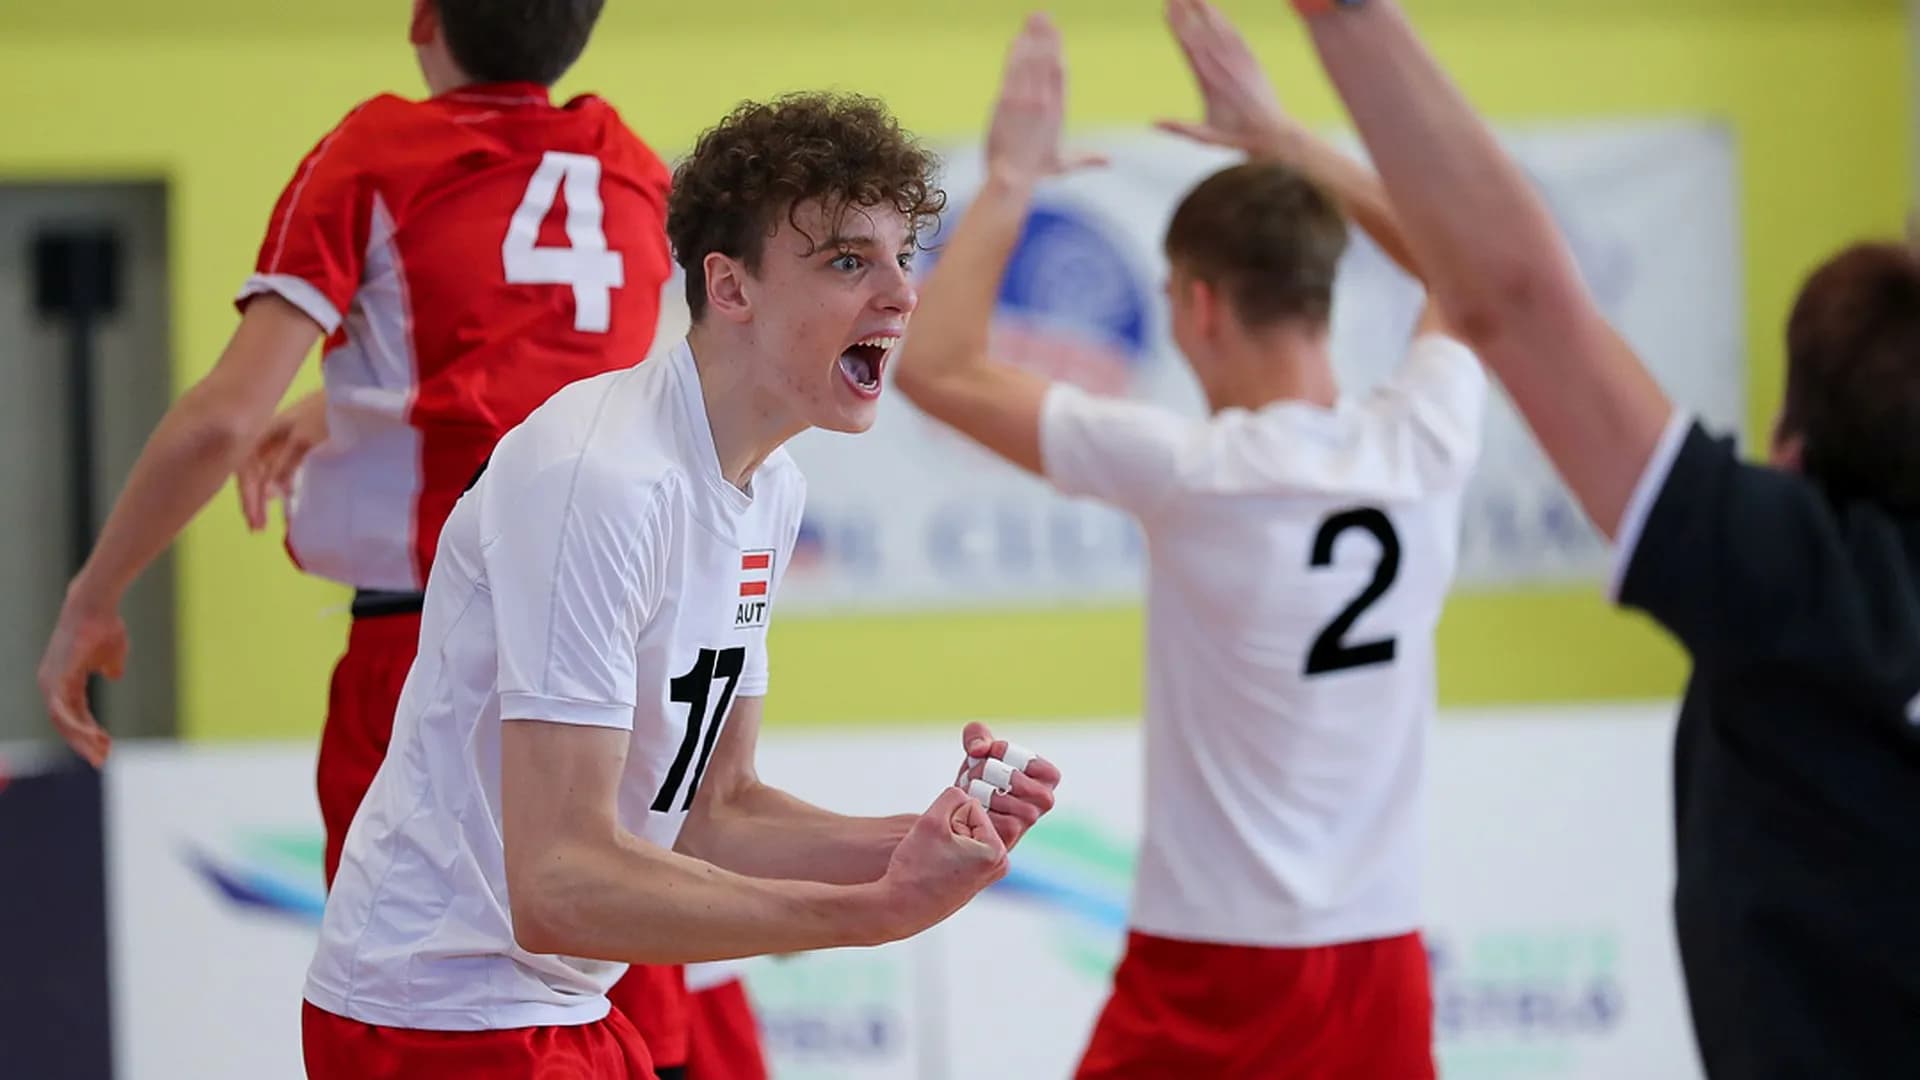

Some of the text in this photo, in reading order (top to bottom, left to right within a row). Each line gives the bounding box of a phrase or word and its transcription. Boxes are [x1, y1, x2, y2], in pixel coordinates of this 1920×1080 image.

[502, 151, 625, 333] 4
[735, 602, 766, 625] AUT
[1303, 506, 1402, 677] 2
[649, 647, 746, 813] 17
